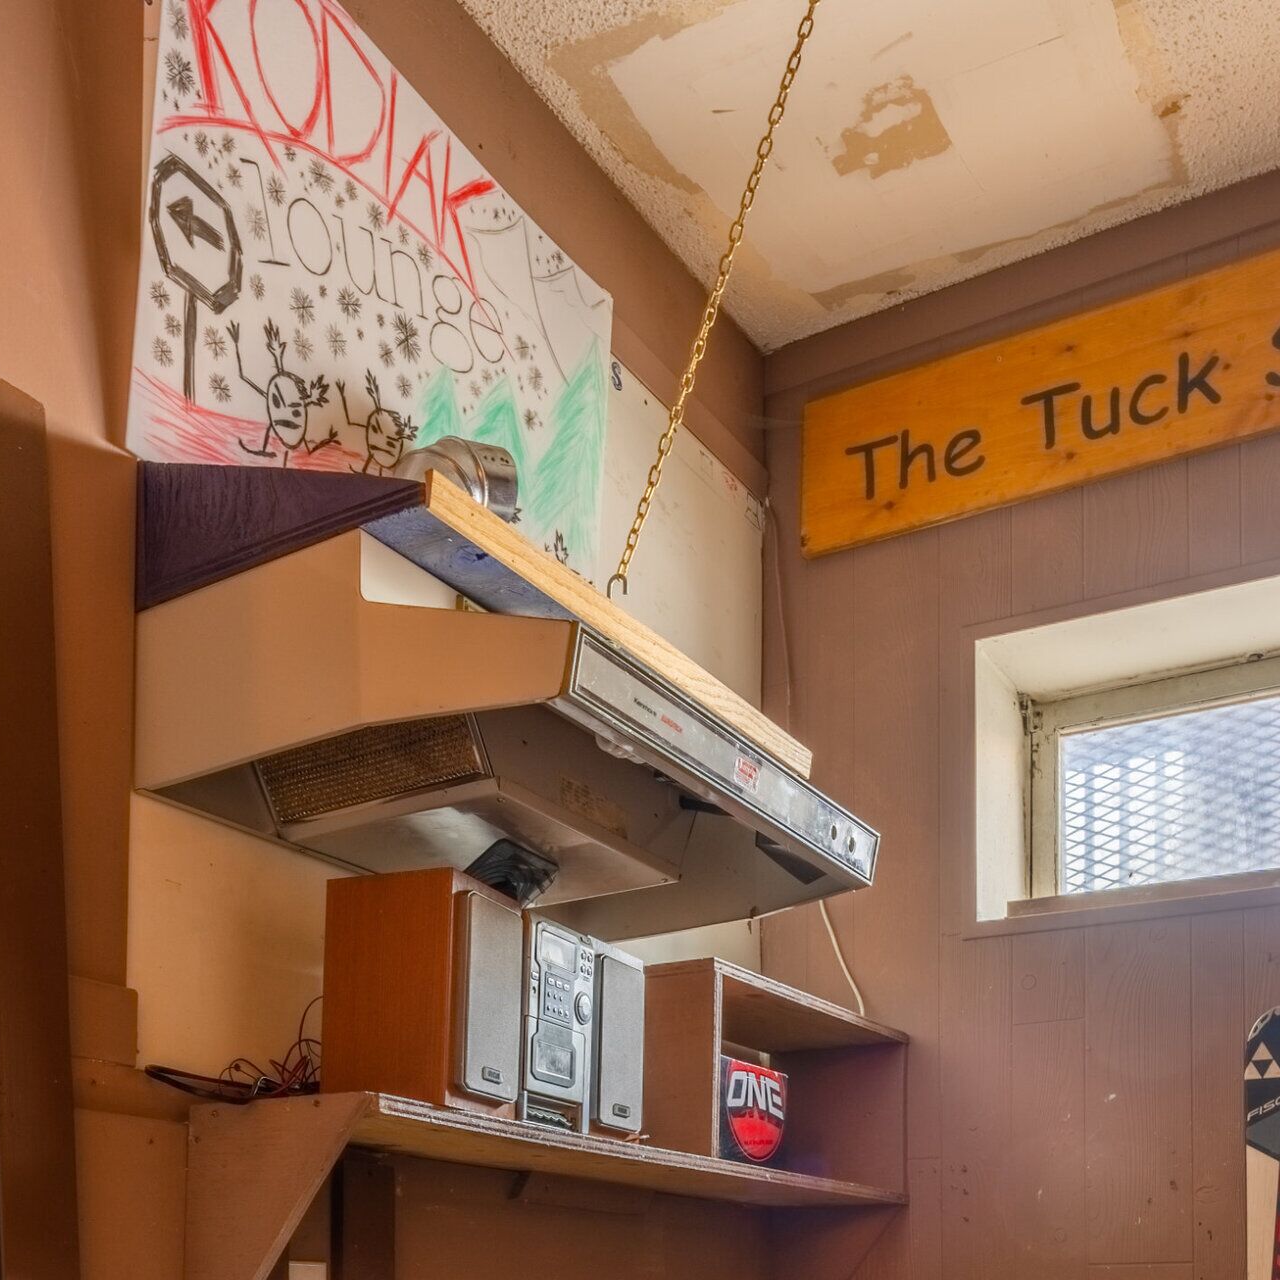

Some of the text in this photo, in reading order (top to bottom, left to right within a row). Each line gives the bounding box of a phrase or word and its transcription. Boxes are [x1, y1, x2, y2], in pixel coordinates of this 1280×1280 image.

[186, 0, 498, 292] KODIAK
[238, 157, 505, 374] lounge
[845, 427, 986, 501] The
[1021, 348, 1225, 450] Tuck
[727, 1071, 785, 1121] ONE
